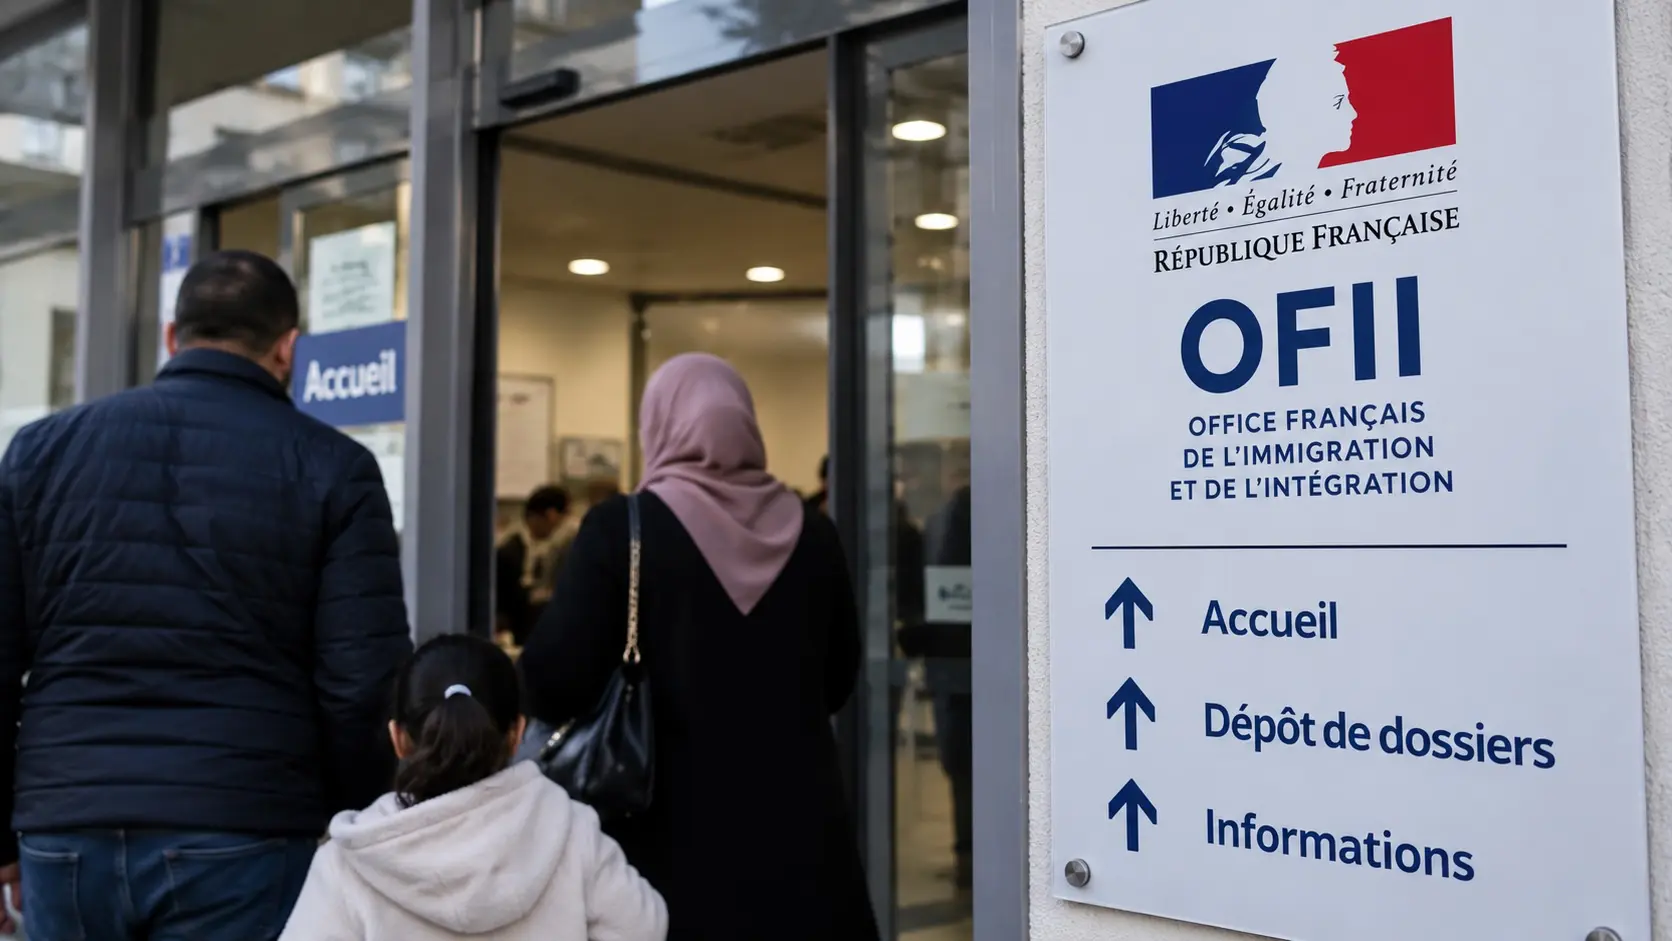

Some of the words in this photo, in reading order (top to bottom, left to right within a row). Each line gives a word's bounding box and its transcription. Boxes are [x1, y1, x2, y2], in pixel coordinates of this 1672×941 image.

[1152, 201, 1219, 230] Liberté
[1241, 184, 1315, 219] Égalité
[1340, 159, 1458, 200] Fraternité
[1153, 231, 1305, 274] RÉPUBLIQUE
[1311, 206, 1461, 250] FRANÇAISE
[1180, 275, 1422, 394] OFII
[303, 347, 397, 403] Accueil
[1188, 410, 1277, 438] OFFICE
[1286, 400, 1427, 432] FRANÇAIS
[1183, 447, 1215, 469] DE
[1223, 435, 1436, 467] L’IMMIGRATION
[1170, 479, 1199, 501] ET
[1205, 478, 1237, 500] DE
[1245, 469, 1454, 499] L’INTÉGRATION
[1200, 599, 1339, 640] Accueil
[1204, 702, 1318, 753] Dépôt
[1322, 710, 1373, 753] de
[1378, 715, 1557, 770] dossiers
[1206, 808, 1476, 882] Informations
